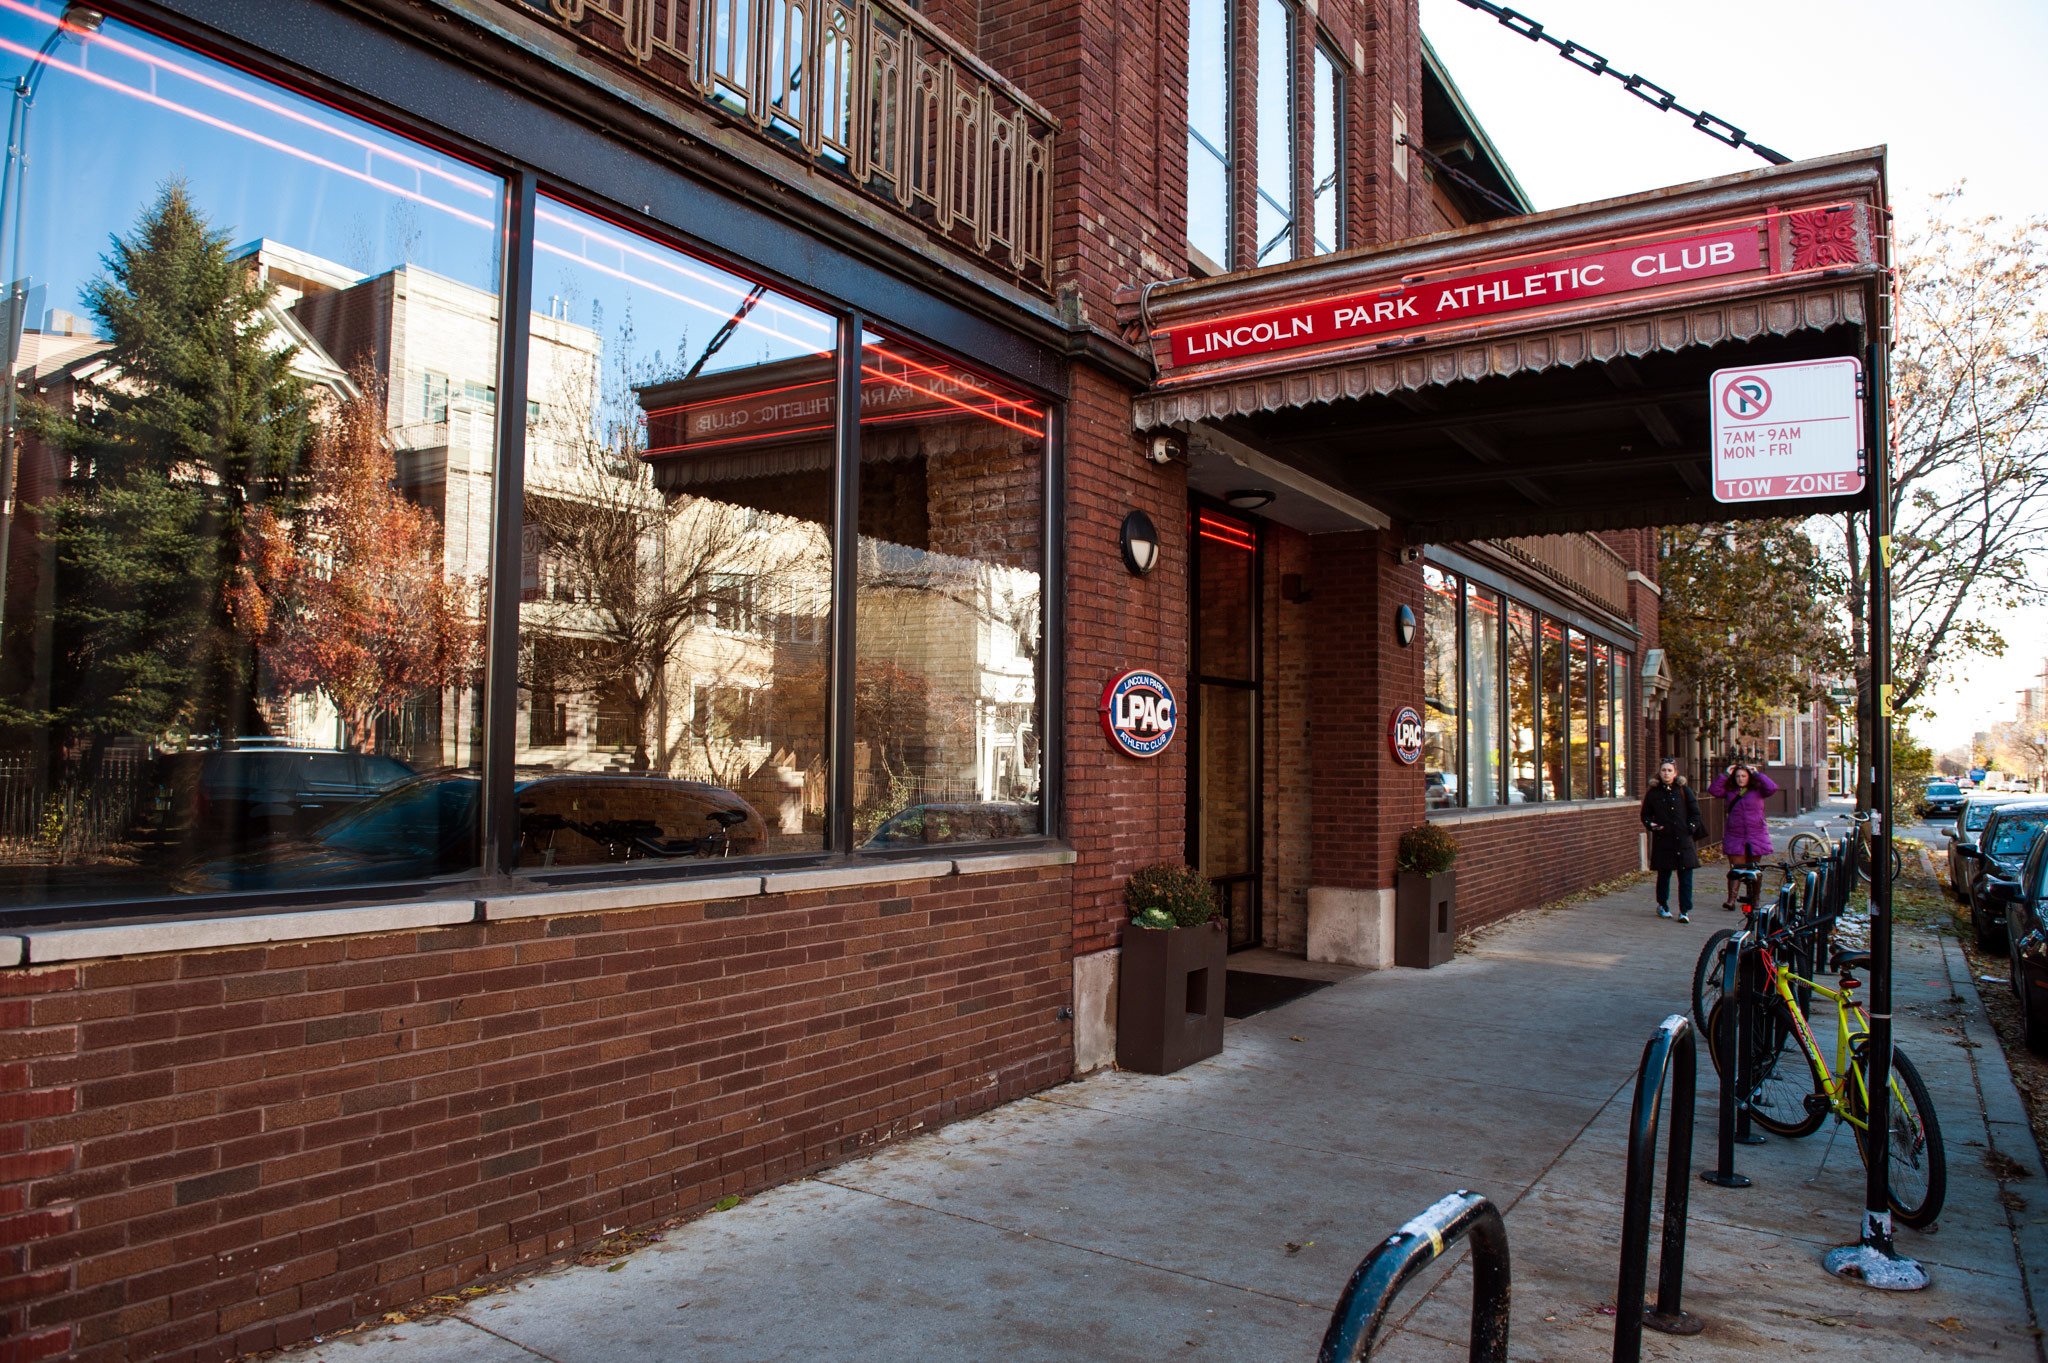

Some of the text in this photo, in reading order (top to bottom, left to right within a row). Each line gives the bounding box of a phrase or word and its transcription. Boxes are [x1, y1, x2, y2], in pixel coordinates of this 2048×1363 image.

[1187, 241, 1736, 356] LINCOLN PARK ATHLETIC CLUB
[1724, 473, 1848, 497] TOW ZONE
[1124, 676, 1164, 693] LINCOLN PARK
[1115, 693, 1173, 732] LPAC
[1120, 731, 1167, 751] ATHLETIC CLUB
[1397, 723, 1422, 748] LPAC
